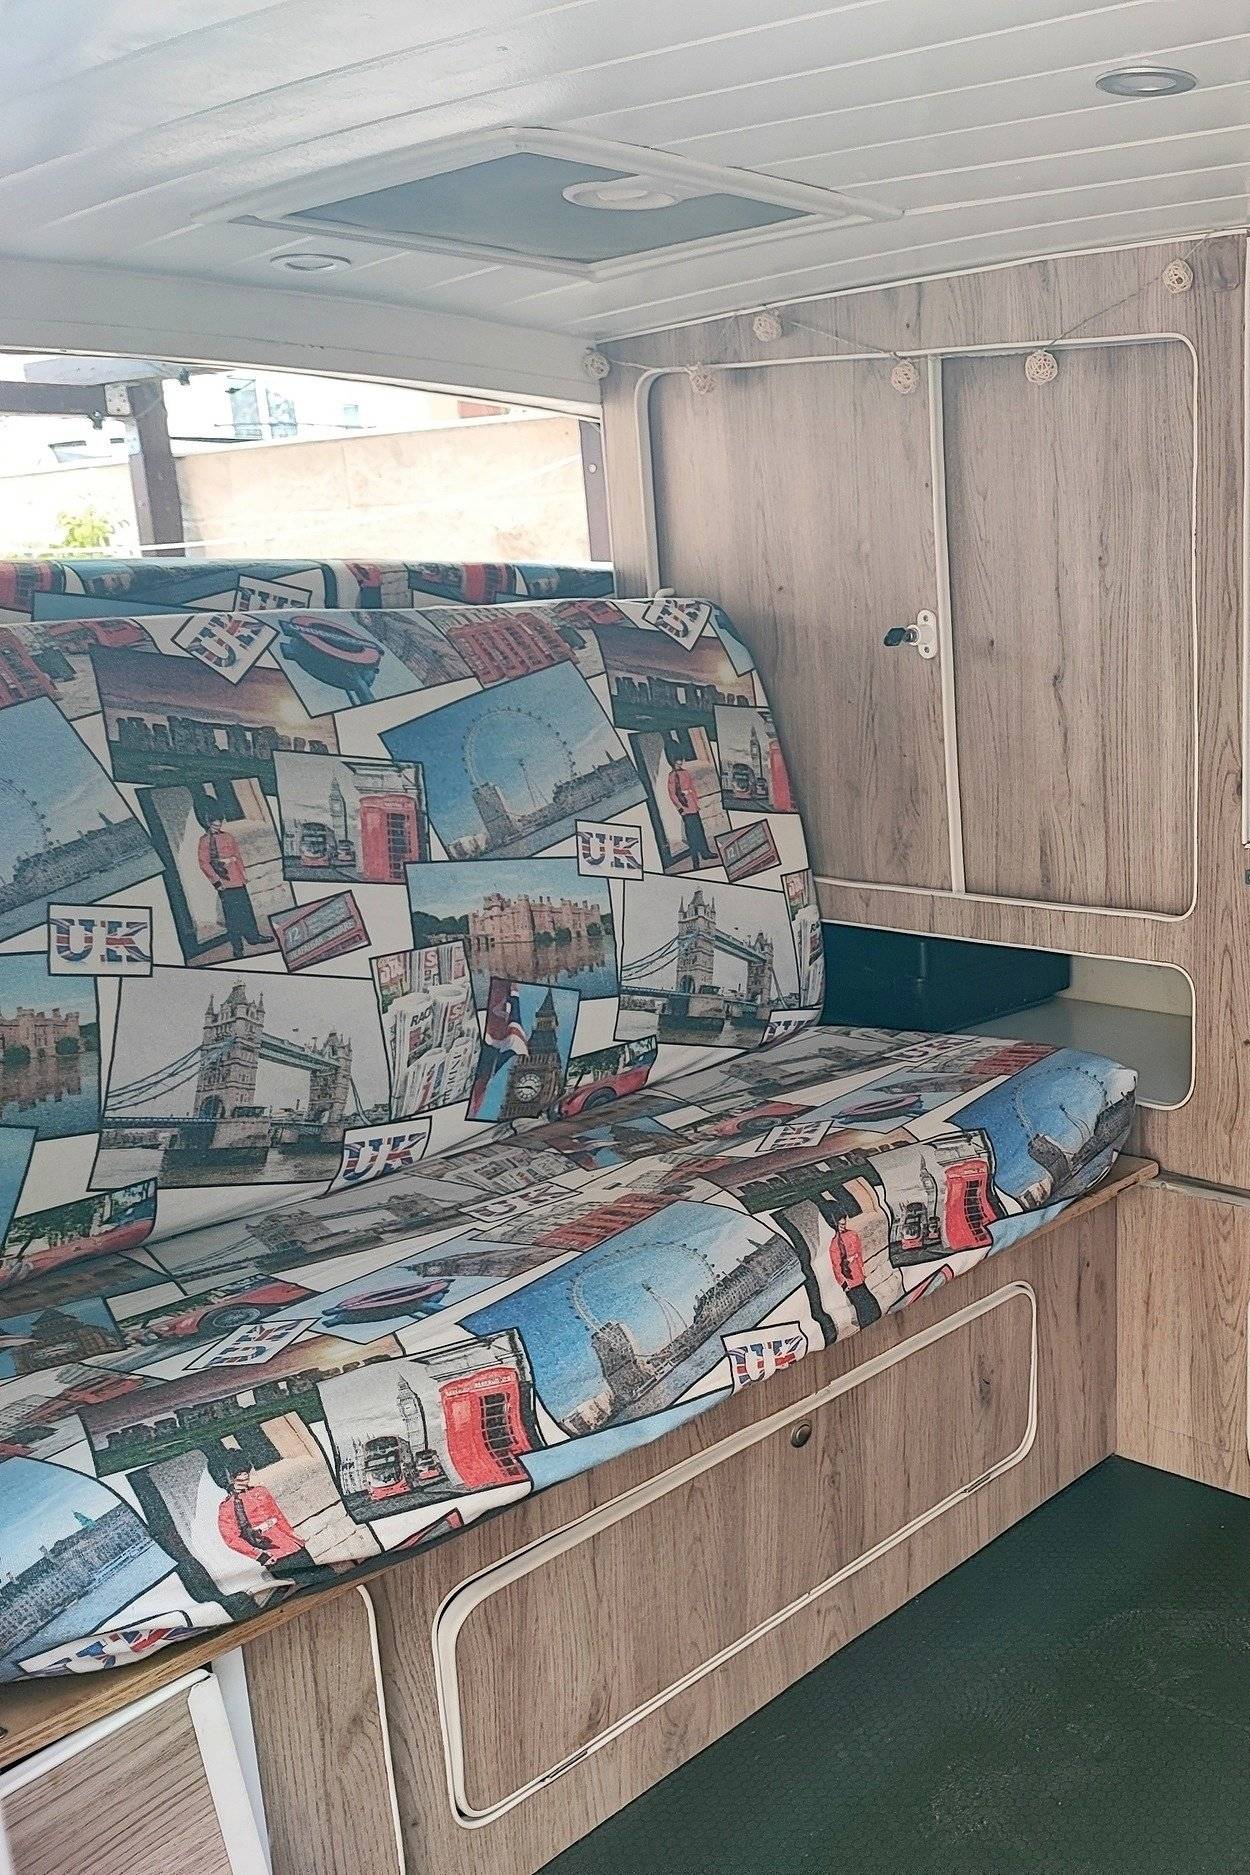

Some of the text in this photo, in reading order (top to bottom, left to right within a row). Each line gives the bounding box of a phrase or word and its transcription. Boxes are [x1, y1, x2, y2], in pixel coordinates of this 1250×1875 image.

[577, 831, 642, 869] UK
[49, 918, 152, 963] UK
[344, 1131, 427, 1181] UK
